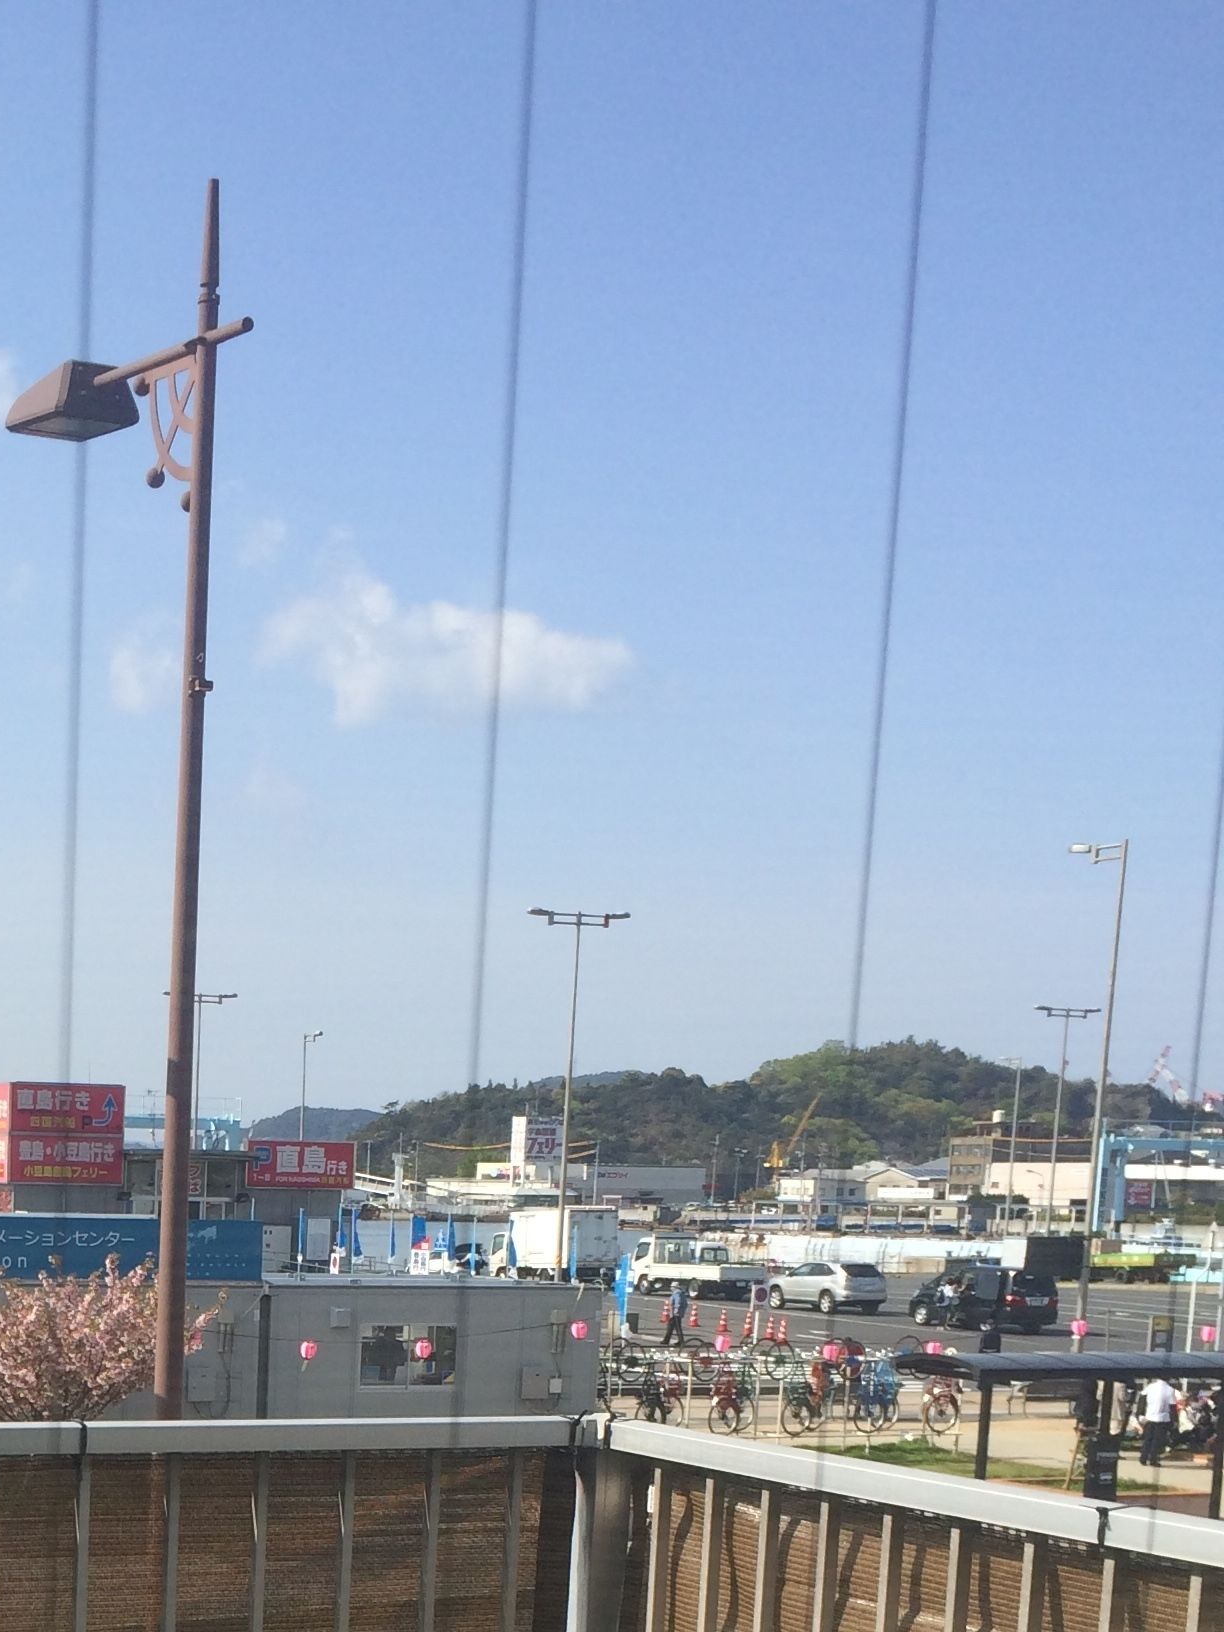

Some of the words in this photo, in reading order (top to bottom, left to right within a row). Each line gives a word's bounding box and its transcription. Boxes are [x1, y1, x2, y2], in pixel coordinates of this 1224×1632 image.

[17, 1089, 90, 1111] 直島行き
[276, 1145, 348, 1175] 直島行き
